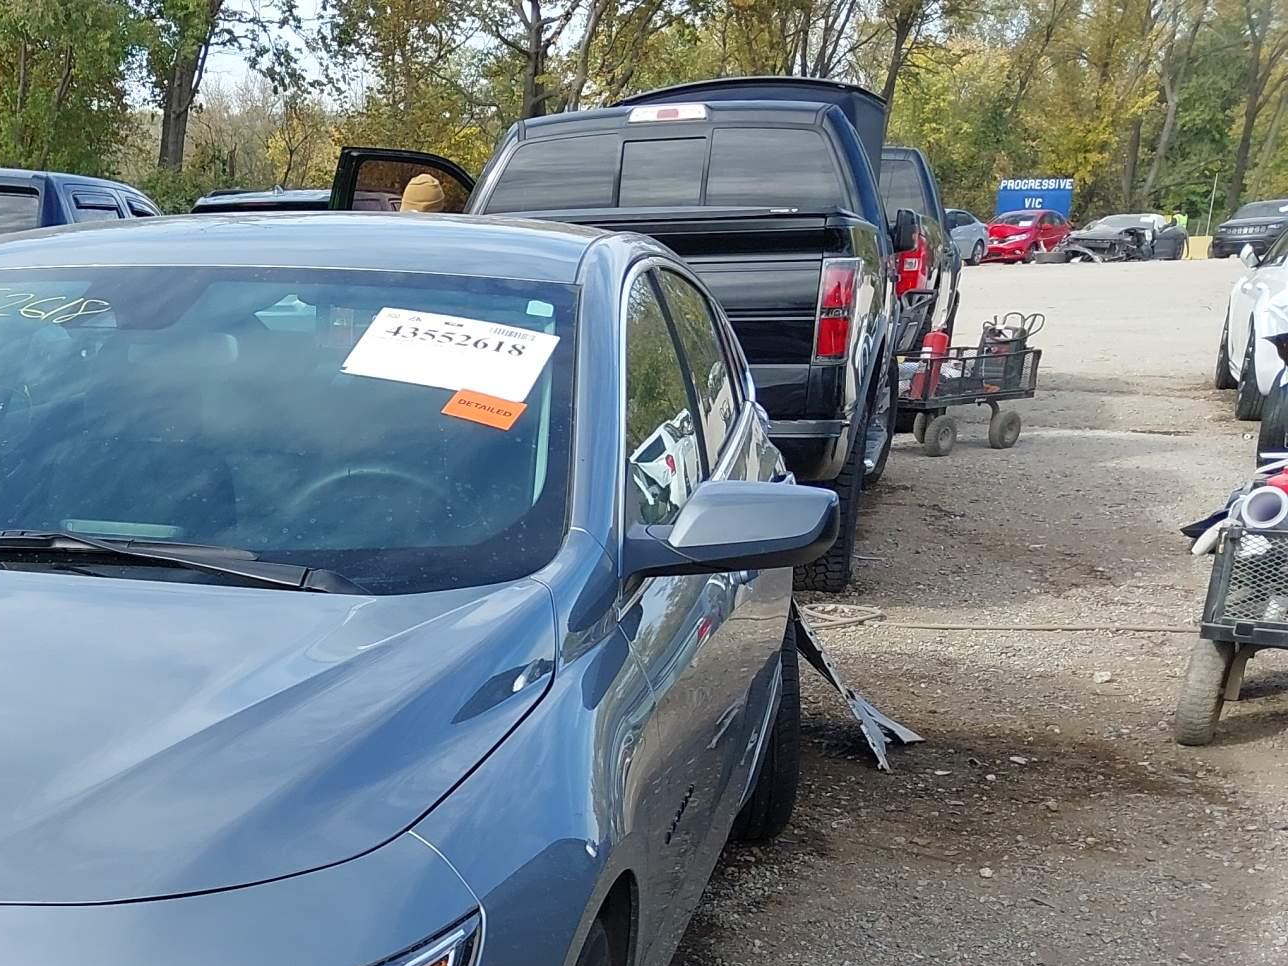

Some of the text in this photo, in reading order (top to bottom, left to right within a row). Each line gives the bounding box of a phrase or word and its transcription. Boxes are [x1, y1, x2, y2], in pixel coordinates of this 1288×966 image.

[999, 178, 1074, 191] PROGRESSIVE
[1024, 197, 1043, 209] VIC
[385, 325, 526, 357] 43552618
[458, 398, 513, 418] DETAILED
